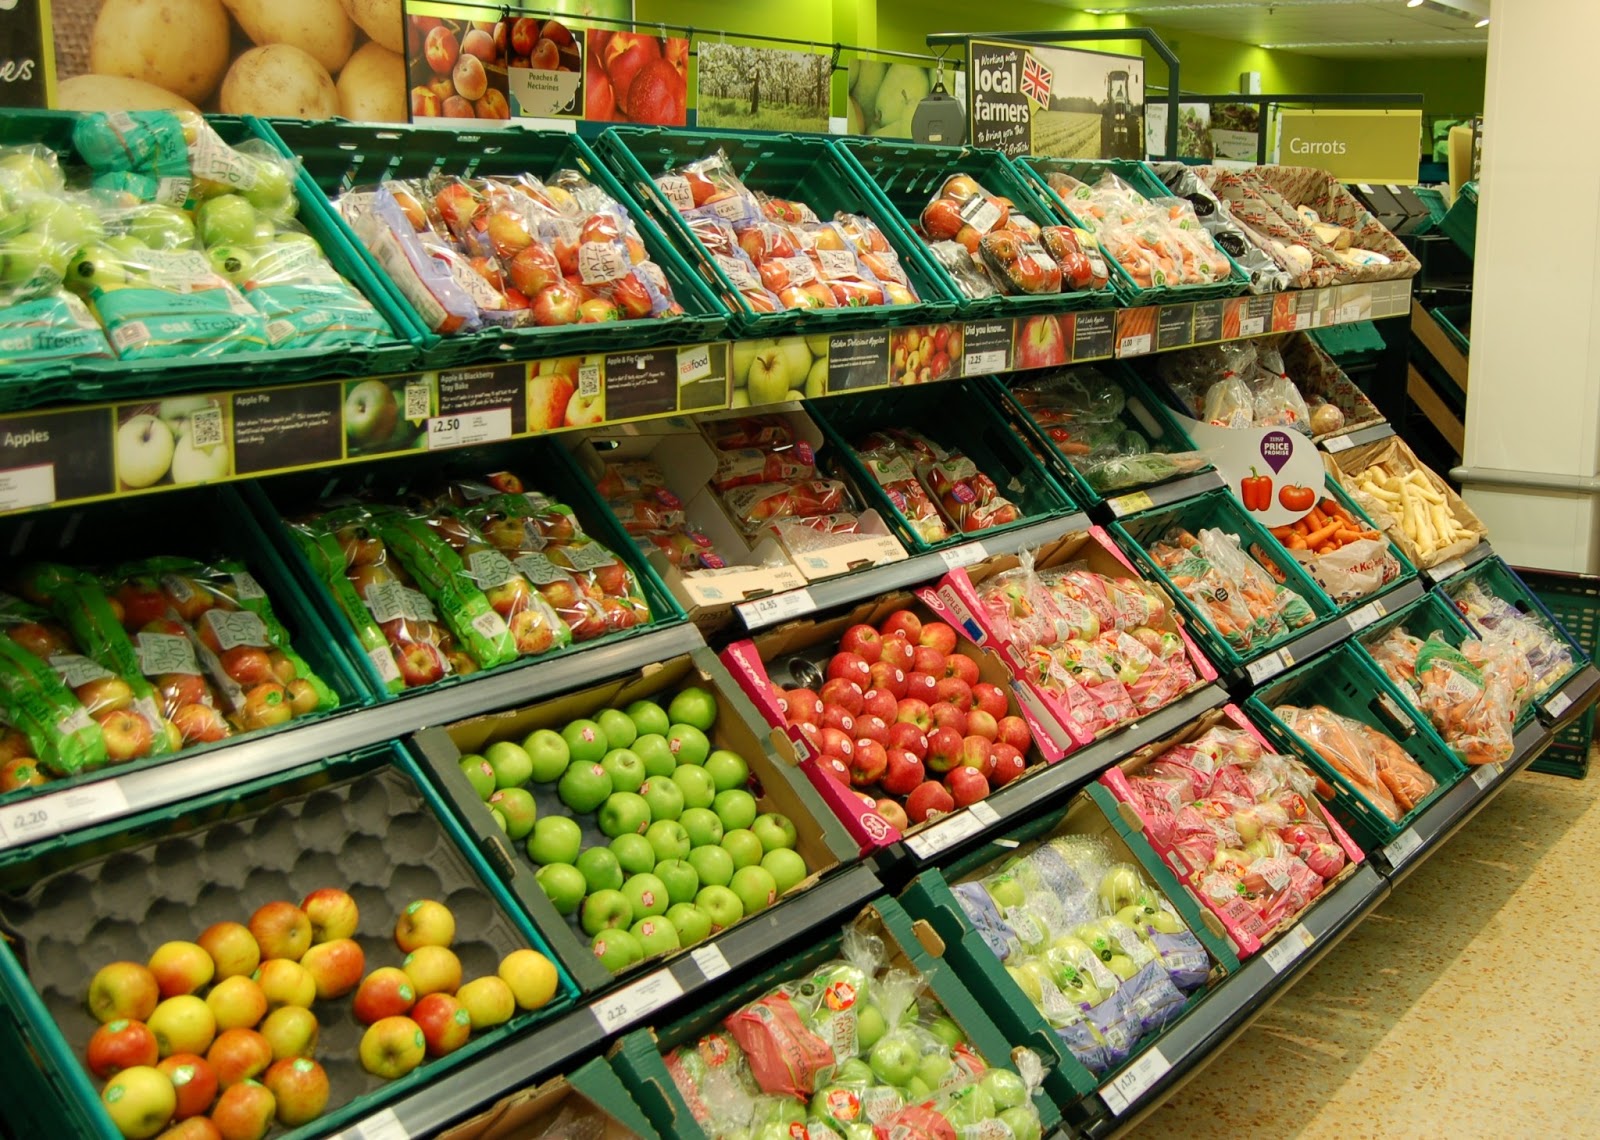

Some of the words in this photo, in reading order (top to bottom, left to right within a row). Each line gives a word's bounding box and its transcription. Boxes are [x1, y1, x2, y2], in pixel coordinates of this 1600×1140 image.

[981, 53, 1005, 70] Working
[1005, 51, 1018, 62] with
[0, 60, 35, 82] es
[528, 72, 552, 82] Peaches
[553, 74, 559, 82] &
[974, 59, 1017, 94] local
[527, 82, 559, 92] Nectarines
[975, 94, 1029, 124] farmers
[1290, 137, 1347, 155] Carrots
[966, 325, 976, 335] Did
[976, 326, 987, 337] you
[869, 336, 886, 347] Apples
[607, 357, 621, 366] Apple
[441, 374, 458, 384] Apple
[459, 373, 464, 381] &
[464, 371, 495, 381] Blackberry
[441, 384, 454, 393] Tray
[455, 382, 470, 391] Bake
[237, 396, 257, 406] Apple
[259, 394, 271, 403] Pie
[4, 429, 50, 448] Apples
[1264, 443, 1289, 451] PRICE
[940, 588, 963, 616] APPLES
